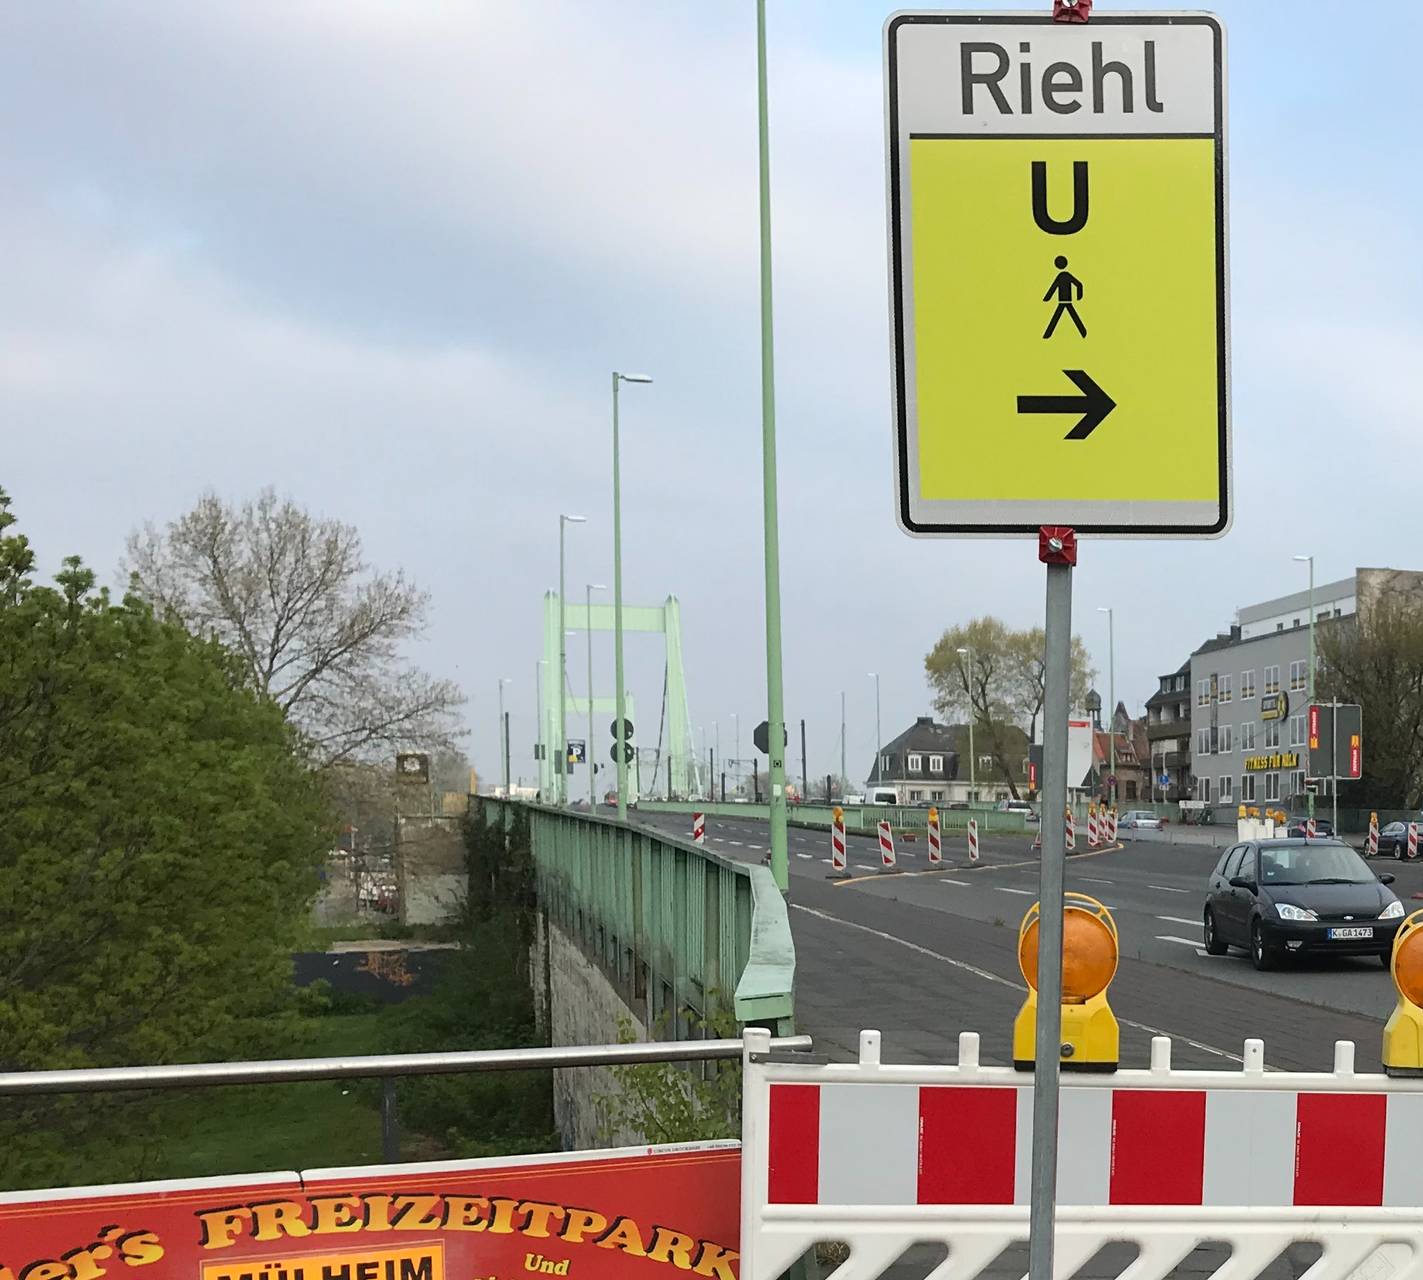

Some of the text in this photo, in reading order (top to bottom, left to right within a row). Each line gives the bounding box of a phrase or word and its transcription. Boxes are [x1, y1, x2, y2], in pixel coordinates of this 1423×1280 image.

[960, 40, 1165, 116] Riehl
[1030, 160, 1090, 236] U
[0, 1193, 741, 1280] er's FREIZEITPARK
[217, 1256, 432, 1280] ÜHEIM
[524, 1253, 571, 1276] Und
